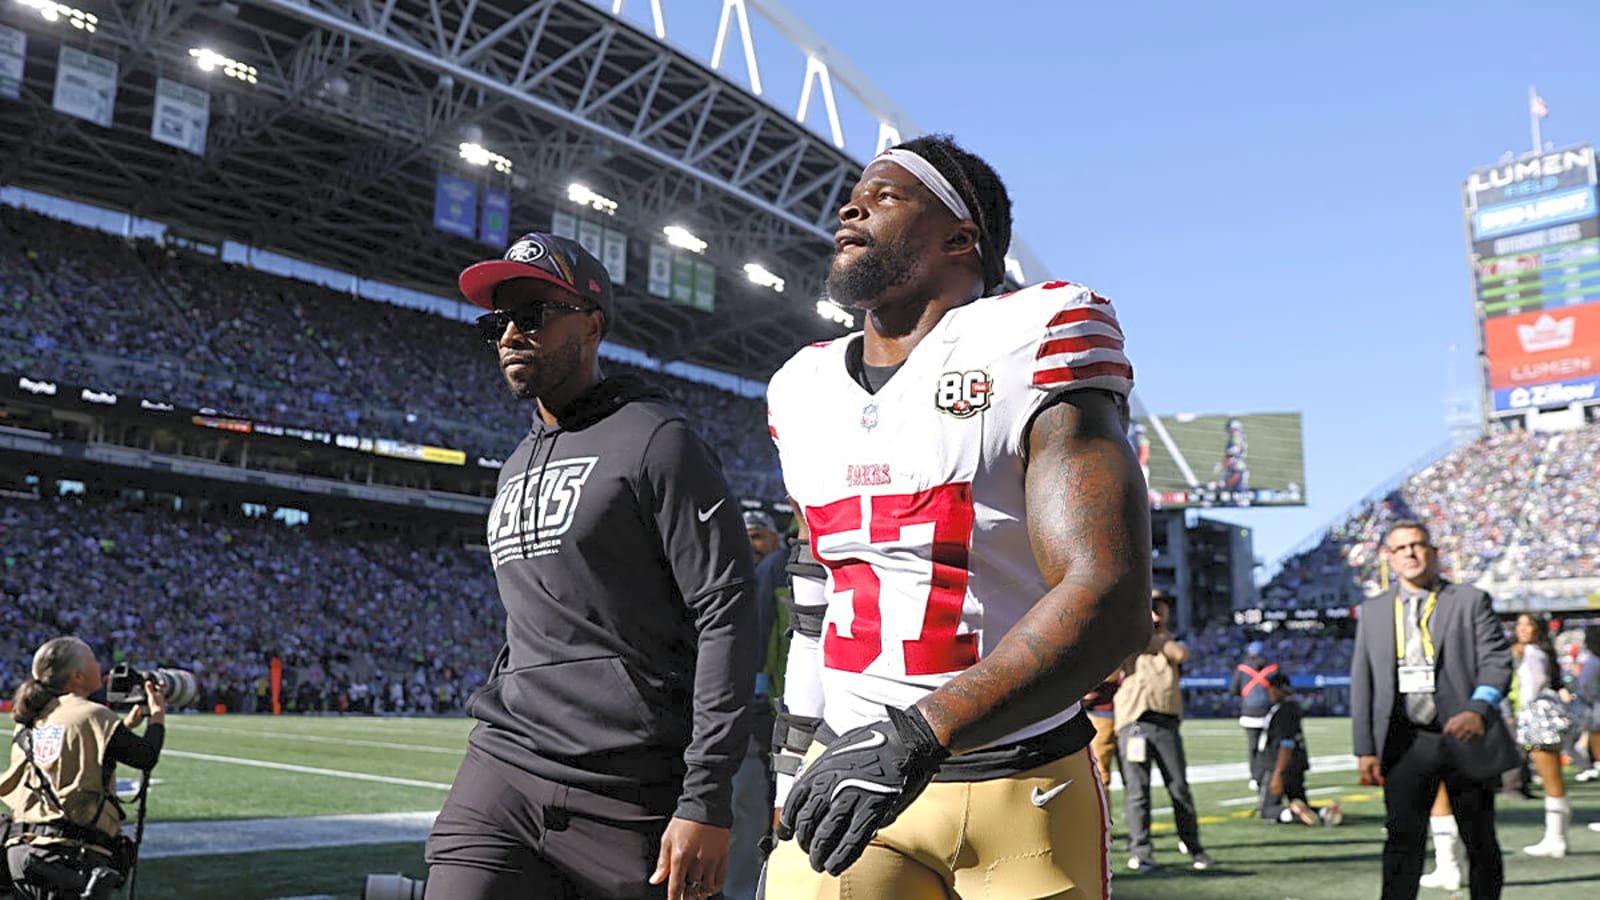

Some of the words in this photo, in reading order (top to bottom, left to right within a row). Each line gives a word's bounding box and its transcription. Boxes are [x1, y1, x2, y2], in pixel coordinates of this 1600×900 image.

[1468, 148, 1590, 192] LUMEN
[1510, 356, 1592, 381] LUMEN
[804, 481, 981, 676] 57
[35, 739, 57, 759] NFL
